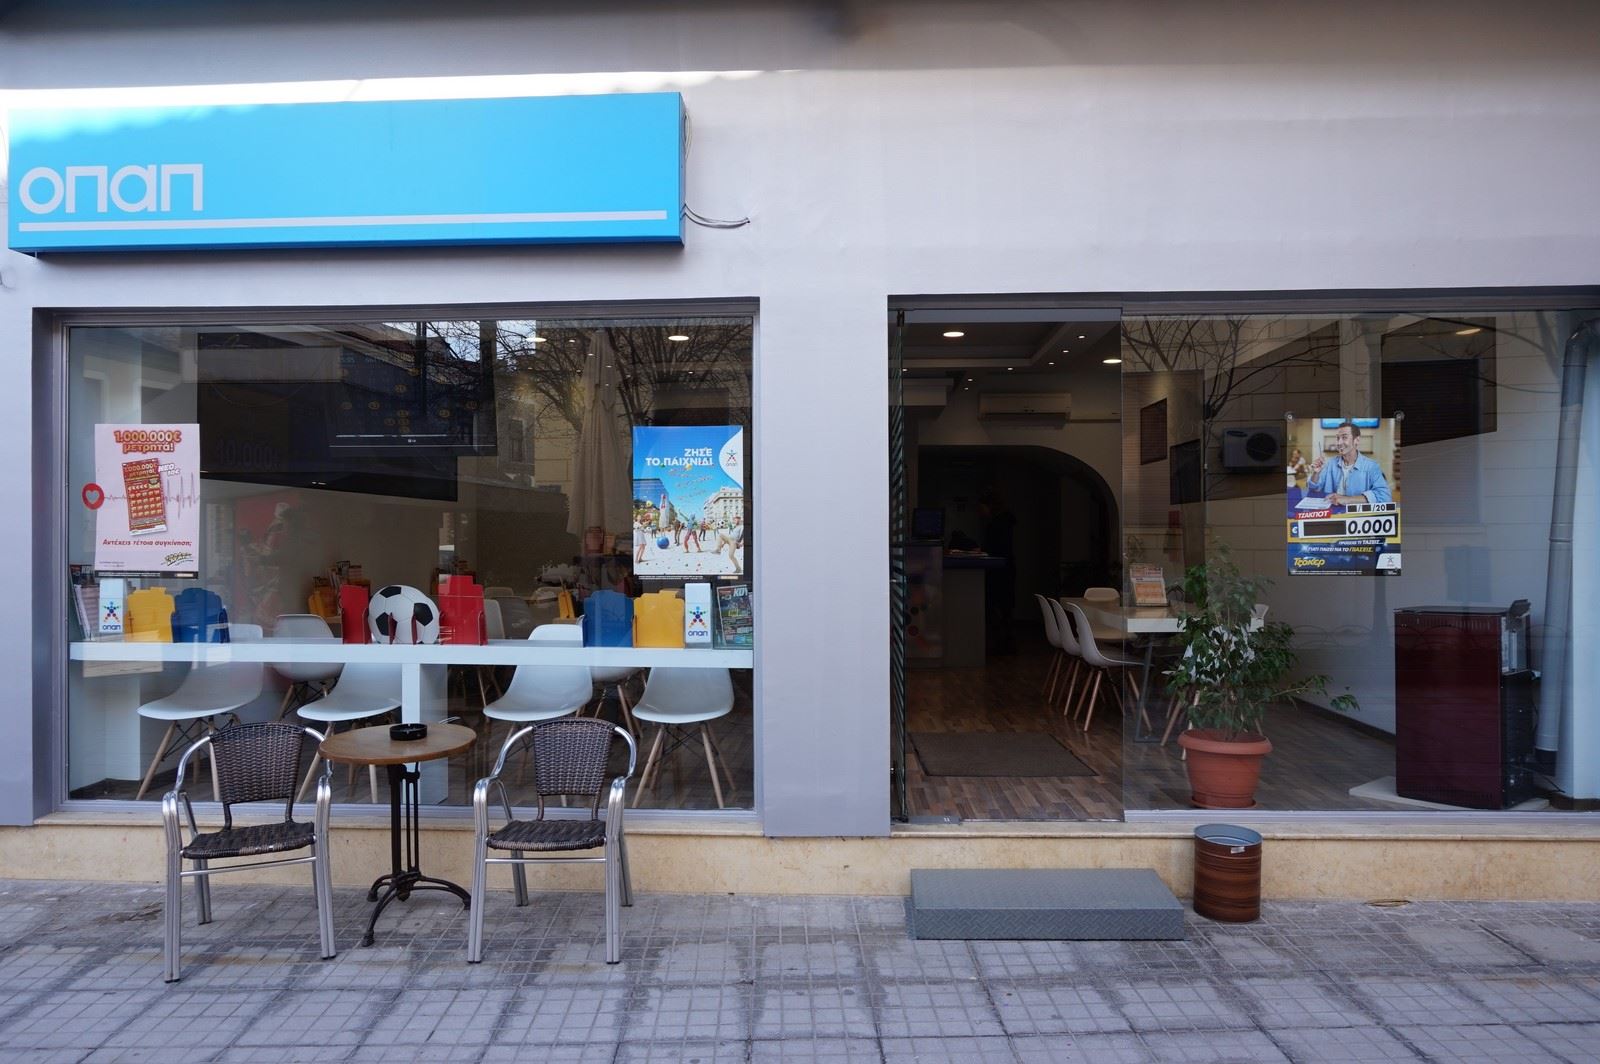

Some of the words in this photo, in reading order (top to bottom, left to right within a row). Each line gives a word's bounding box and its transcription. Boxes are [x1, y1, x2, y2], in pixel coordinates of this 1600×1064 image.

[684, 448, 713, 457] ΖΗΣΕ
[645, 458, 661, 466] ΤΟ
[1298, 510, 1330, 519] ΤΖΑΚΠΟΤ
[1347, 519, 1393, 535] 0.000
